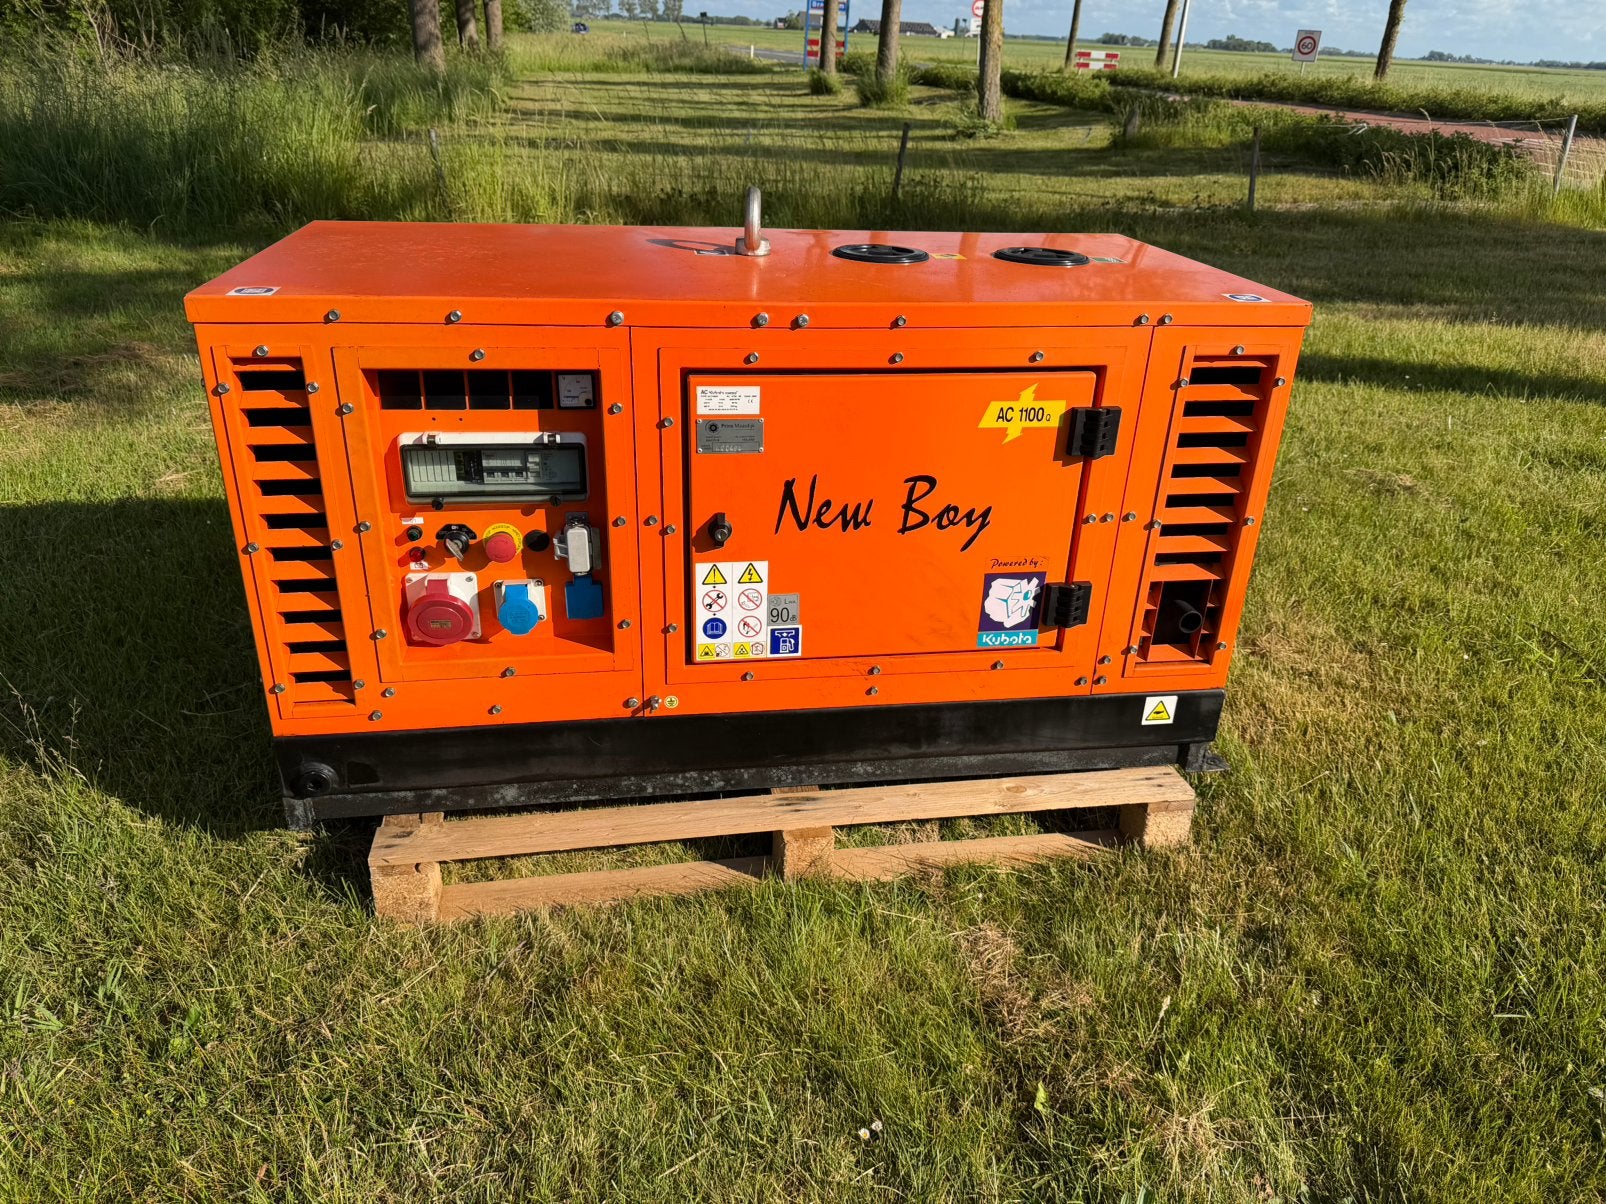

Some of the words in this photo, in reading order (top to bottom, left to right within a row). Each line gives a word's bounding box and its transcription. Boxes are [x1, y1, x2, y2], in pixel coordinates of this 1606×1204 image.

[1301, 41, 1313, 50] 60
[995, 406, 1014, 423] AC
[1018, 406, 1045, 423] 1100
[774, 473, 874, 535] New
[897, 474, 992, 552] Boy
[990, 558, 1028, 569] Powered
[770, 607, 790, 623] 90
[790, 614, 798, 622] dB
[982, 632, 1032, 645] Kubota
